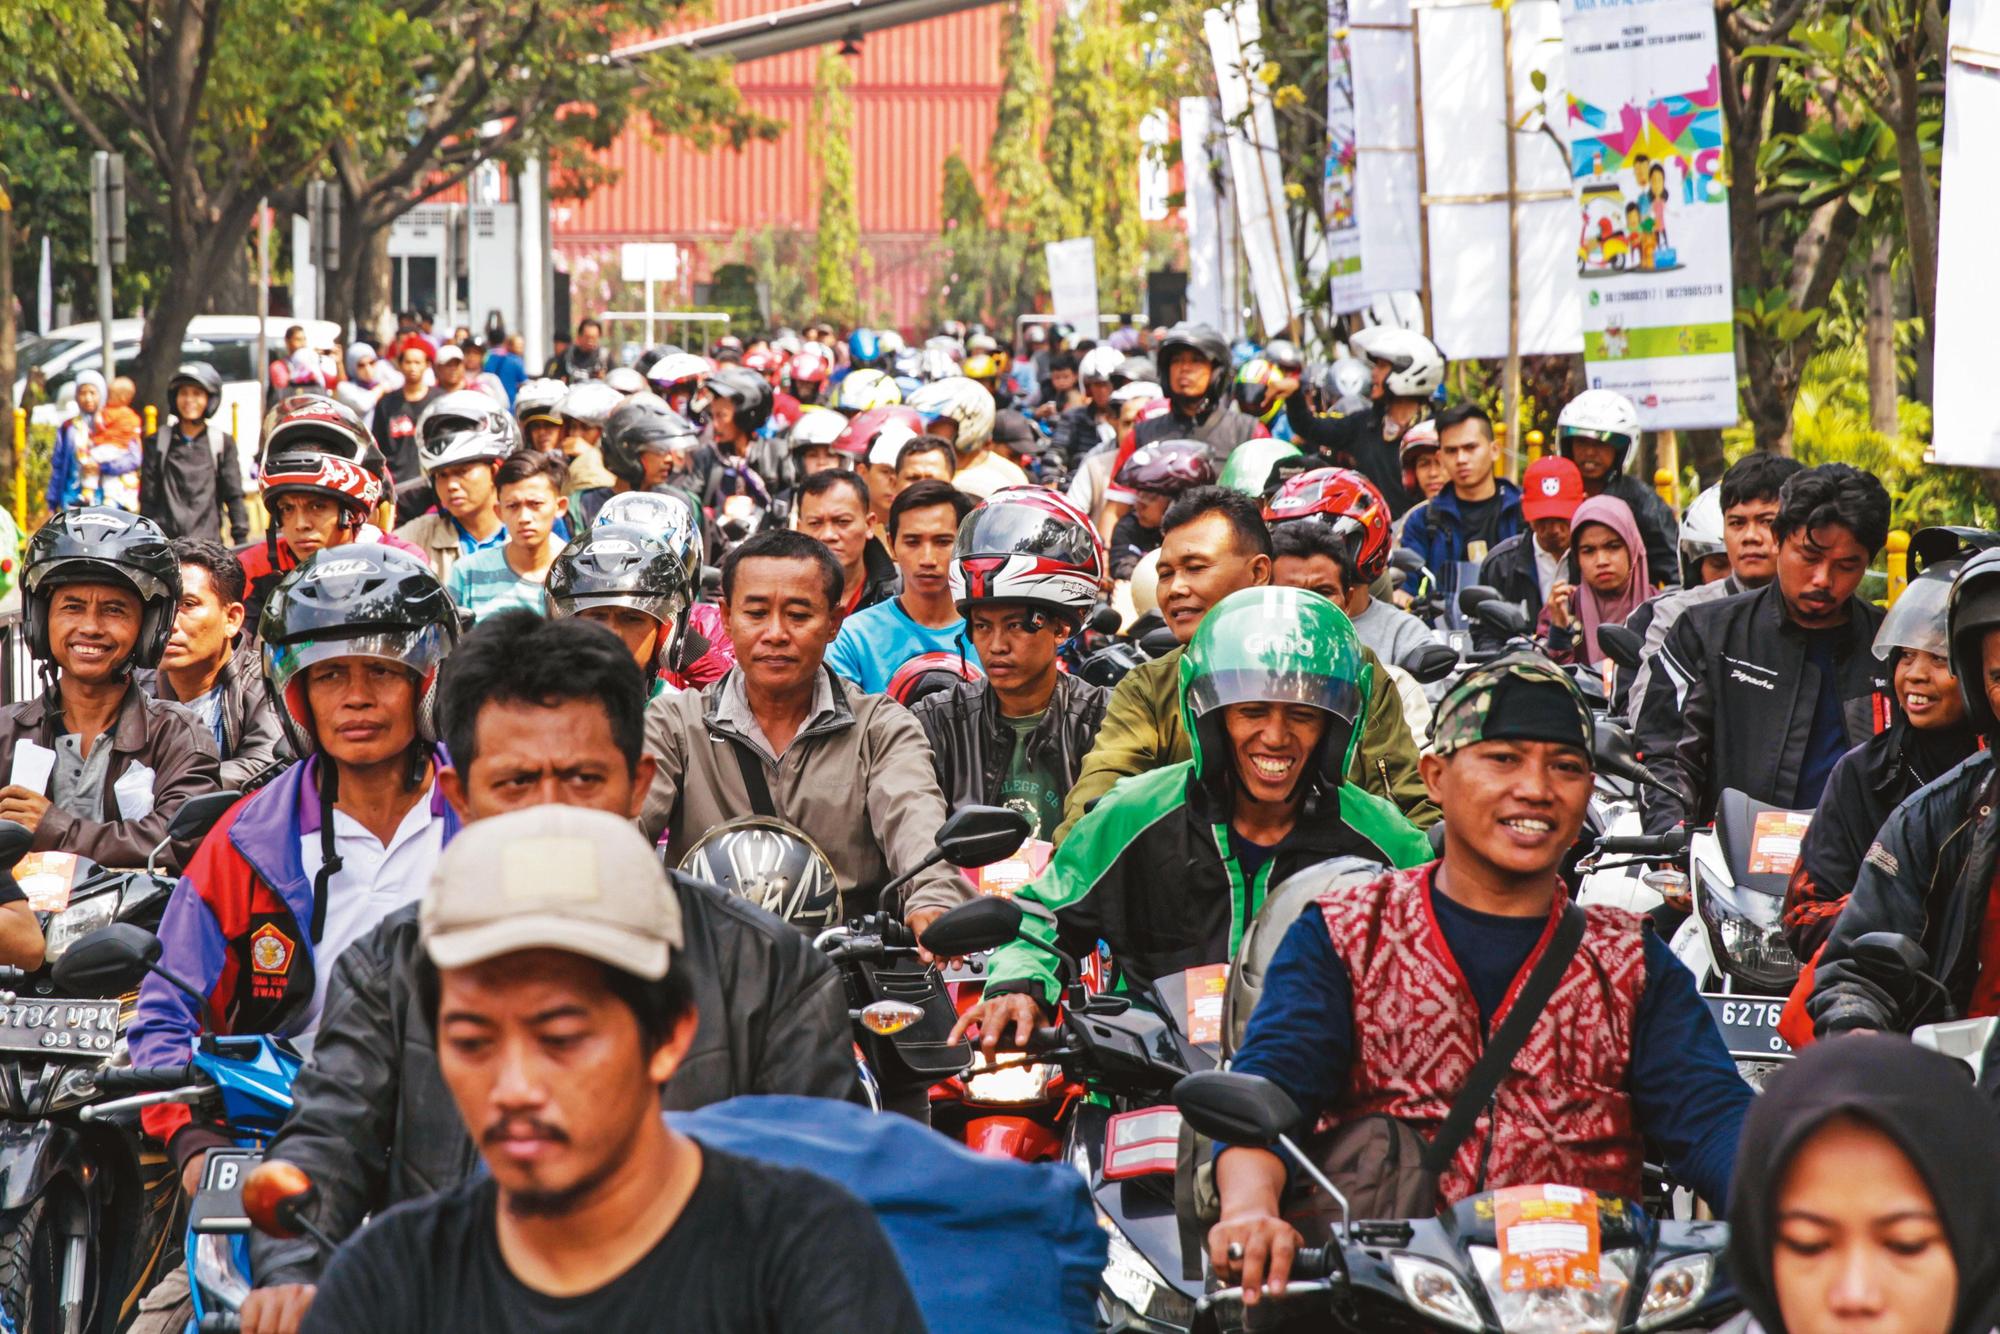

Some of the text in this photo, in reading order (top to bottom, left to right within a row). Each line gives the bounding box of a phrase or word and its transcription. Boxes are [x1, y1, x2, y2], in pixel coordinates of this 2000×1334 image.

[1244, 630, 1314, 657] Grab
[66, 1007, 115, 1030] UPK
[1722, 1002, 1781, 1027] 6276
[77, 1033, 111, 1050] 20
[218, 1161, 239, 1191] B
